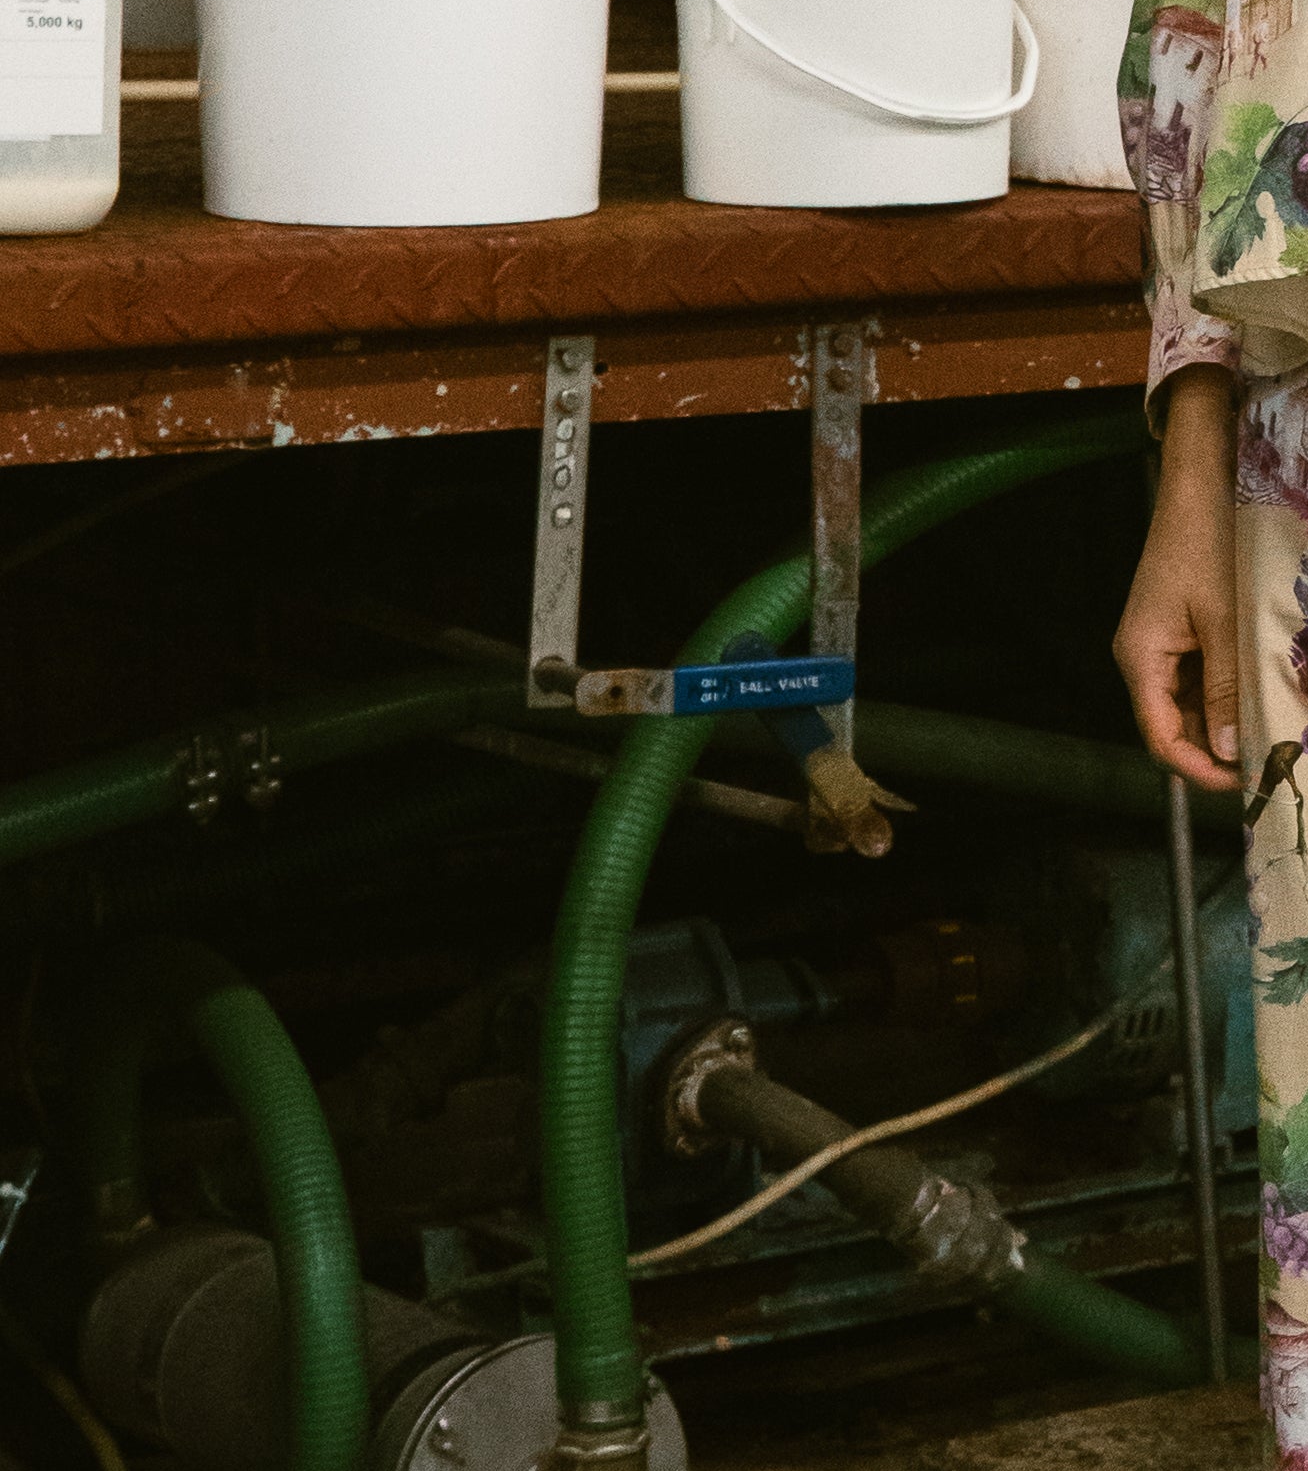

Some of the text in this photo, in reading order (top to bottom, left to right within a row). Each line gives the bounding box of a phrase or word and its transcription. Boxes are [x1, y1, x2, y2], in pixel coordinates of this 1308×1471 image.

[67, 15, 83, 31] kg
[739, 674, 820, 694] BALL VALVE
